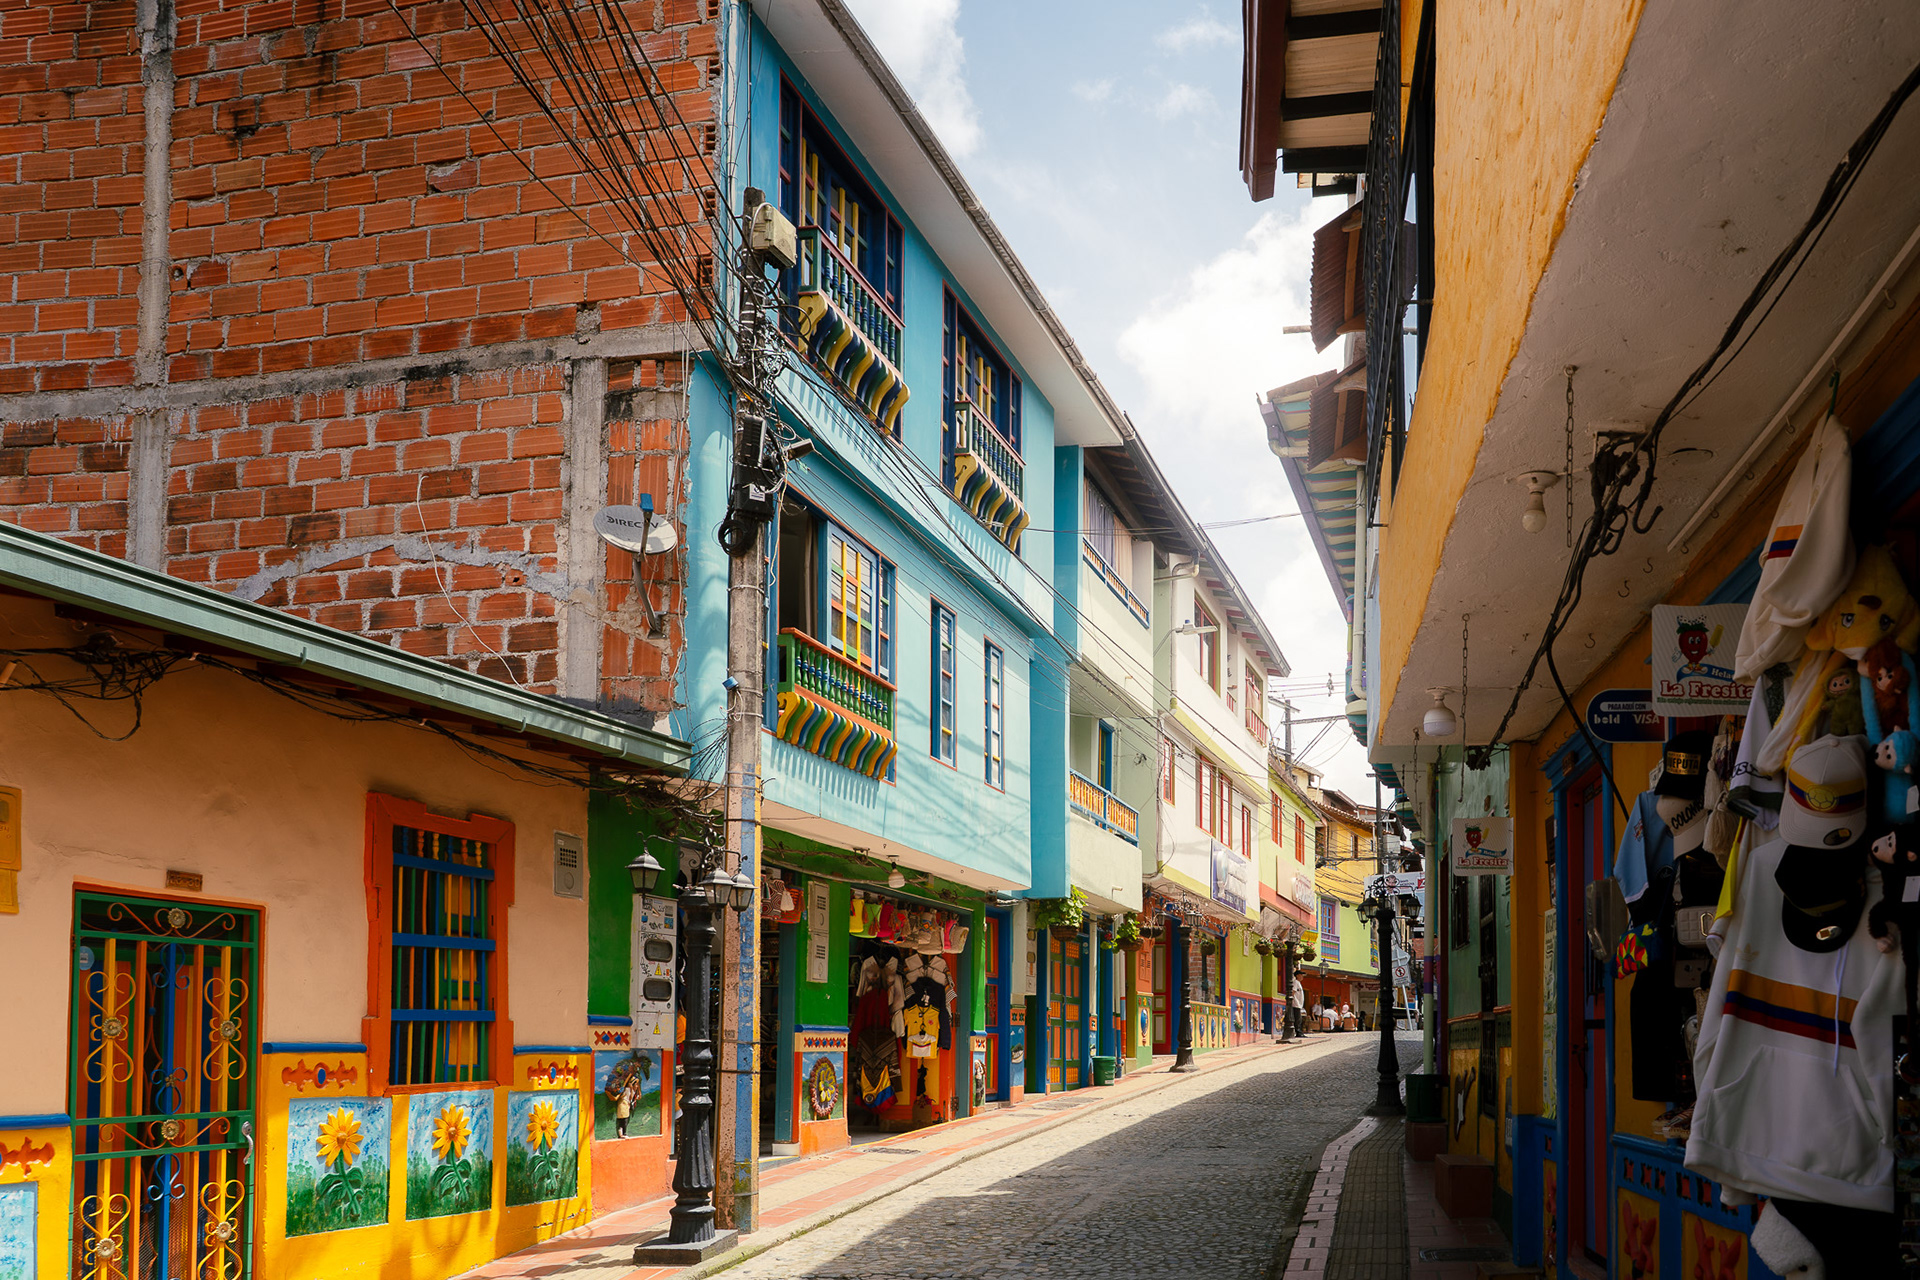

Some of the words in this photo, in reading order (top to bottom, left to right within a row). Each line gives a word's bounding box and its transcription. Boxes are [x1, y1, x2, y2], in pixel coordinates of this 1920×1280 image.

[606, 515, 659, 528] DIRECV
[1660, 680, 1685, 697] La
[1688, 680, 1755, 698] Fresita
[1594, 713, 1621, 725] bold
[1632, 713, 1660, 725] VISA
[1458, 856, 1471, 866] La
[1472, 856, 1509, 867] Fresita
